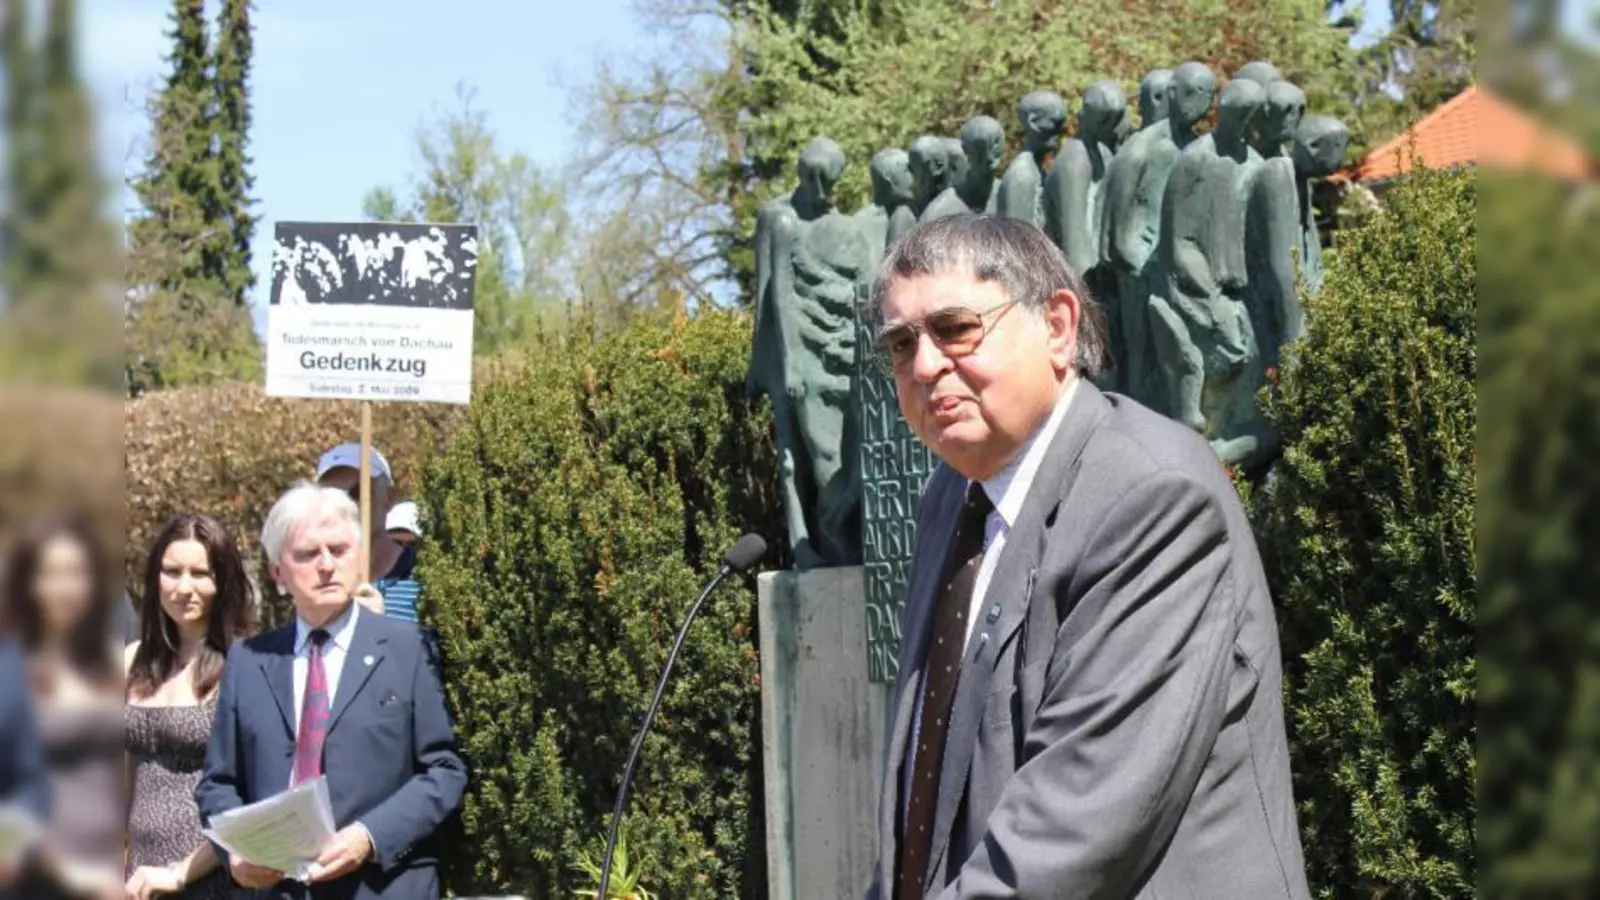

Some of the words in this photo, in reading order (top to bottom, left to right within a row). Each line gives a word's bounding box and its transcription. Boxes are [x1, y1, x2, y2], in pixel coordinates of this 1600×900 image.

[282, 332, 368, 346] Todesmarsch
[371, 338, 395, 347] von
[400, 336, 453, 350] Dachau
[299, 350, 427, 378] Gedenkzug
